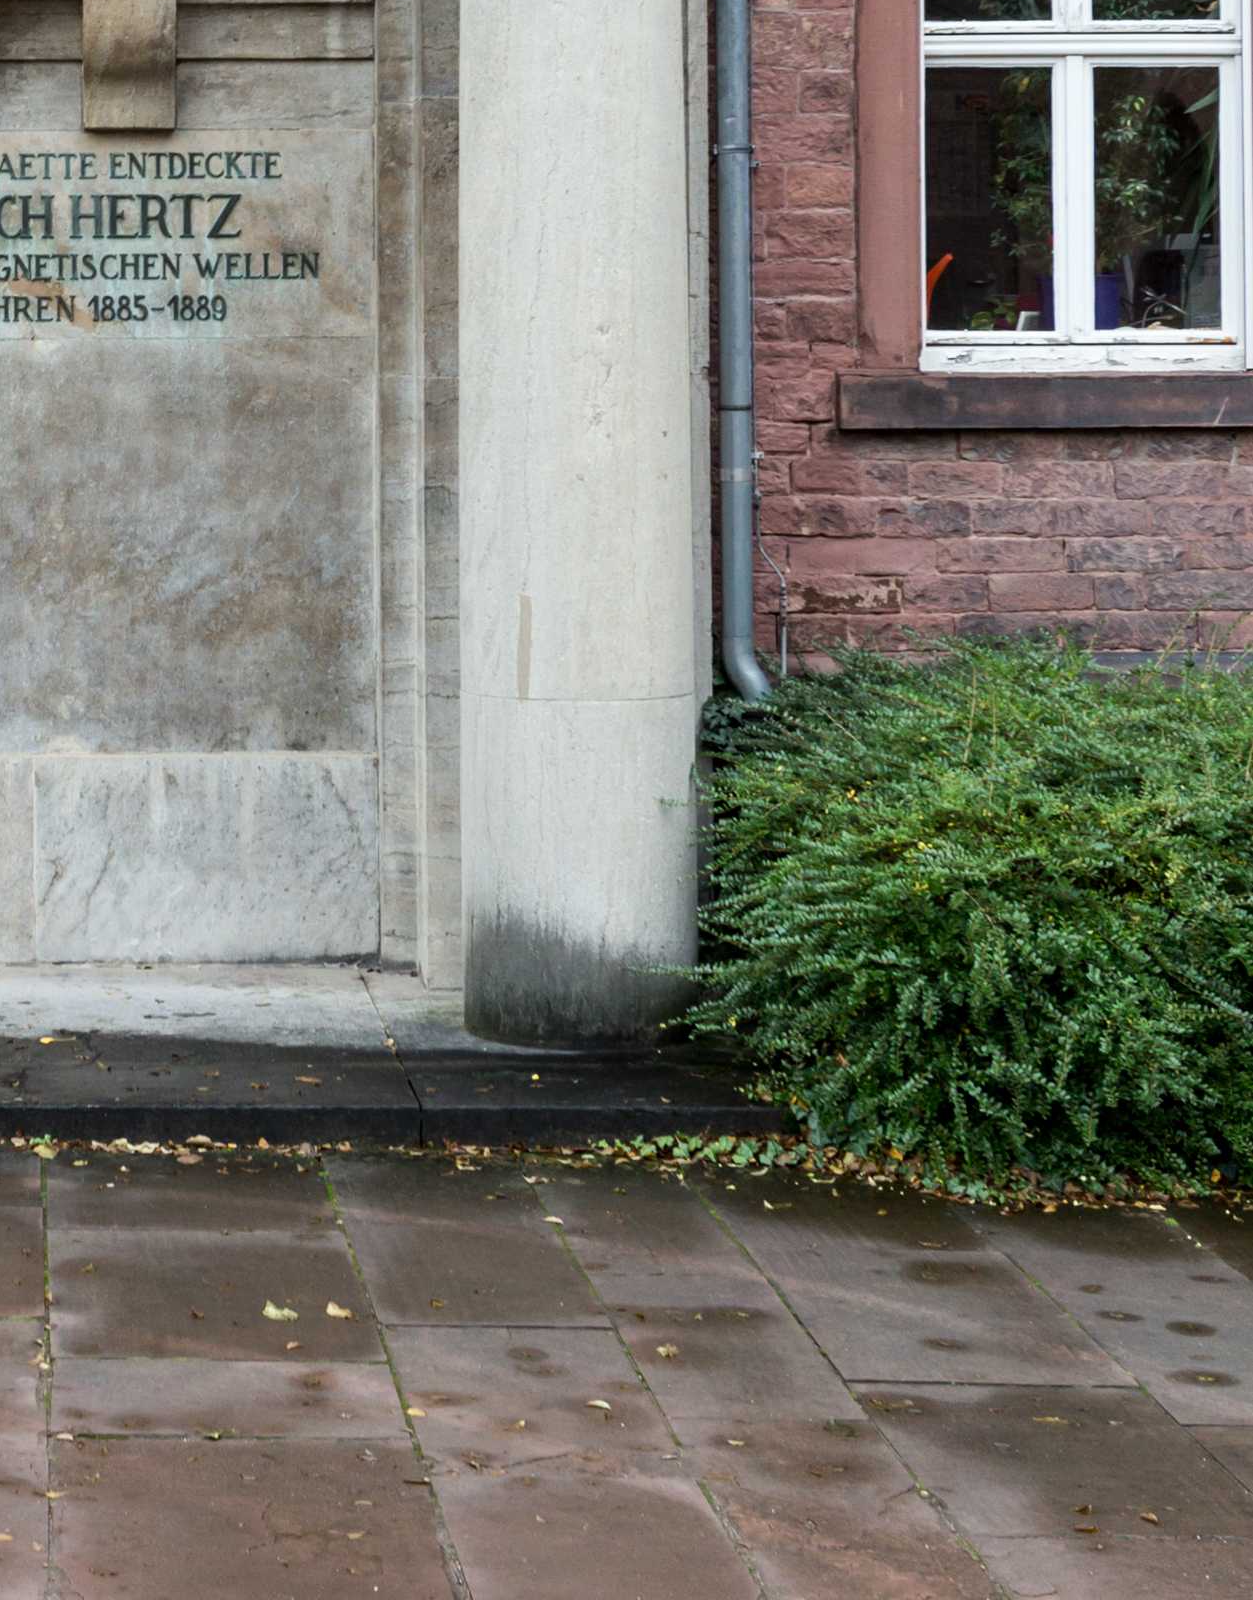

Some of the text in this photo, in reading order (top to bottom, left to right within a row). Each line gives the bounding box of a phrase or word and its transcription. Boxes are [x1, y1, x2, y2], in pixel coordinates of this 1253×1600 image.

[109, 151, 282, 180] ENTDECKTE
[69, 193, 242, 239] HERTZ
[193, 252, 320, 280] WELLEN
